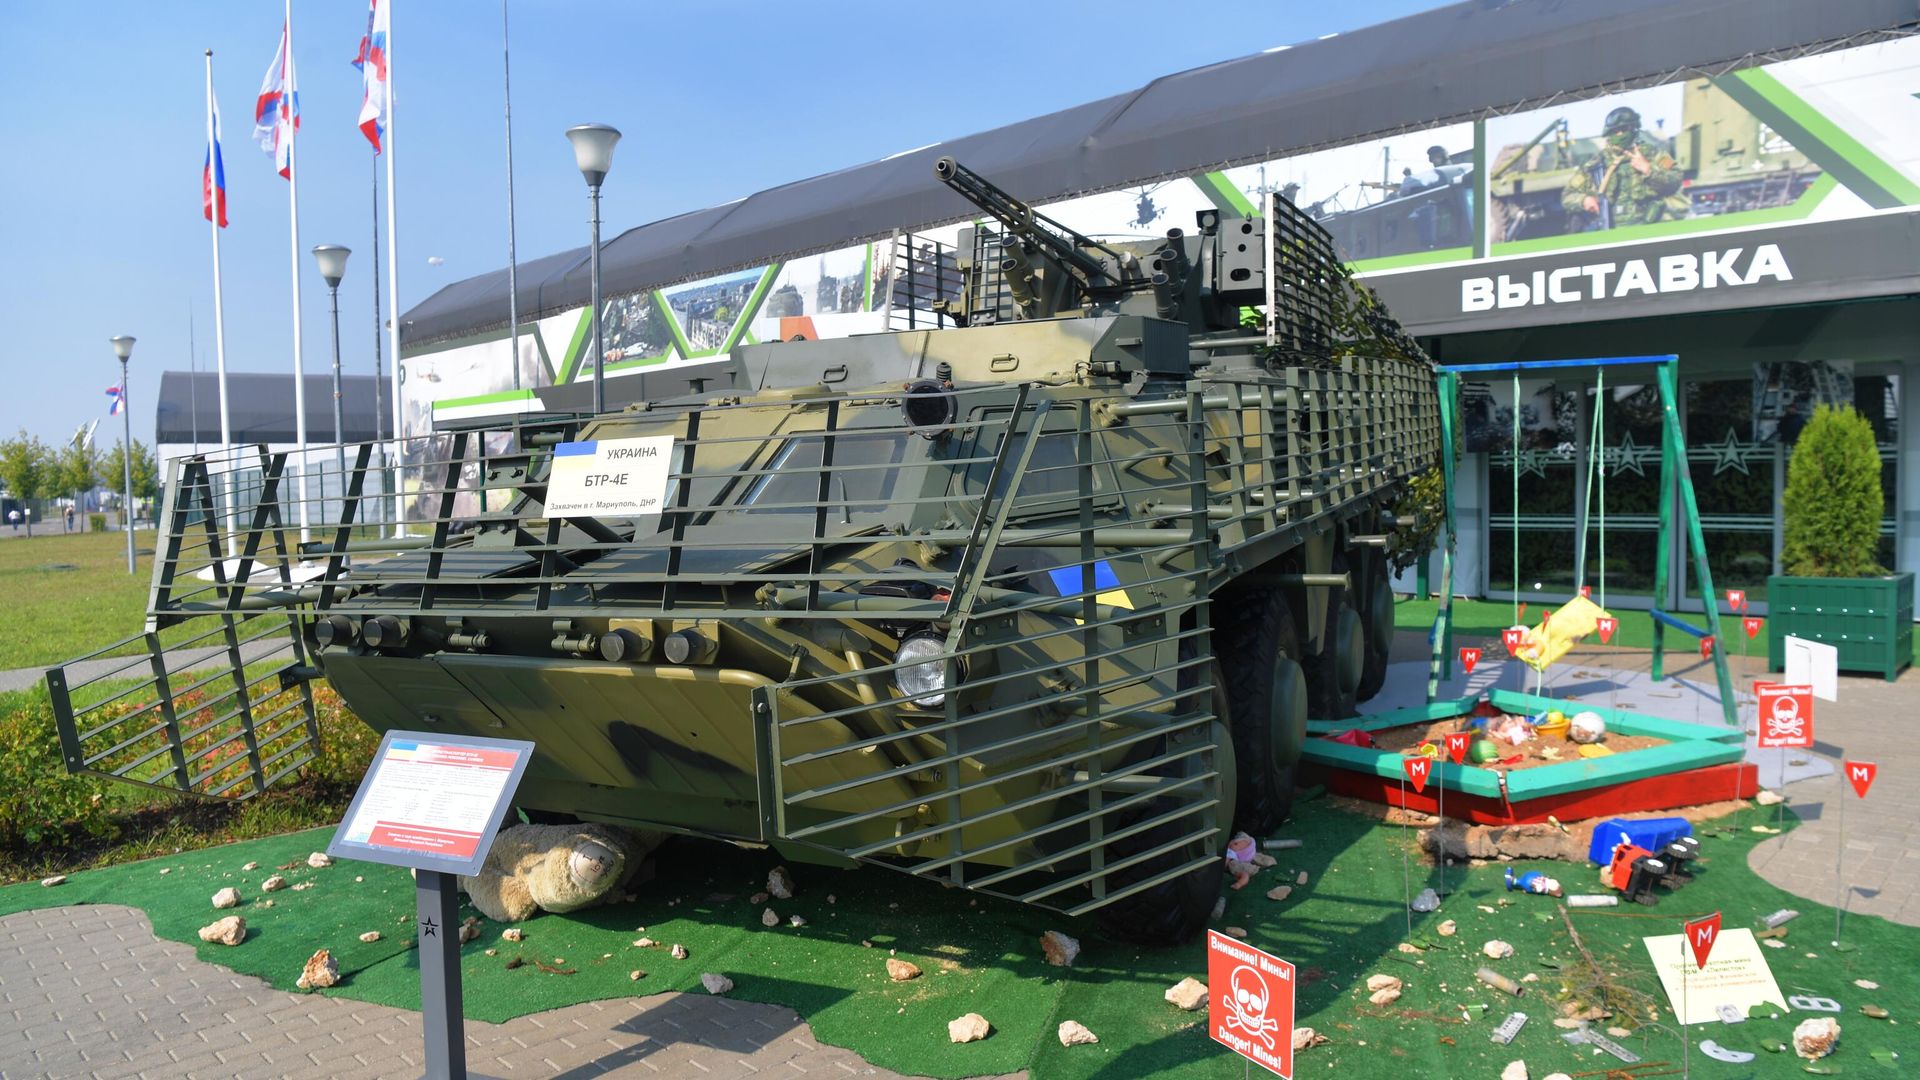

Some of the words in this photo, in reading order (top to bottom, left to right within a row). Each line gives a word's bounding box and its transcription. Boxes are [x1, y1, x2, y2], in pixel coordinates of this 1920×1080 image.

[1462, 244, 1793, 312] ВЫСТАВКА
[607, 447, 657, 459] УКРАИНА
[584, 473, 629, 487] БТР-4Е
[640, 498, 657, 507] ДНР
[1210, 935, 1258, 967] Внимание!
[1260, 955, 1290, 982] Мины!
[1218, 1026, 1250, 1052] Danger!
[1253, 1043, 1282, 1070] Mines!
